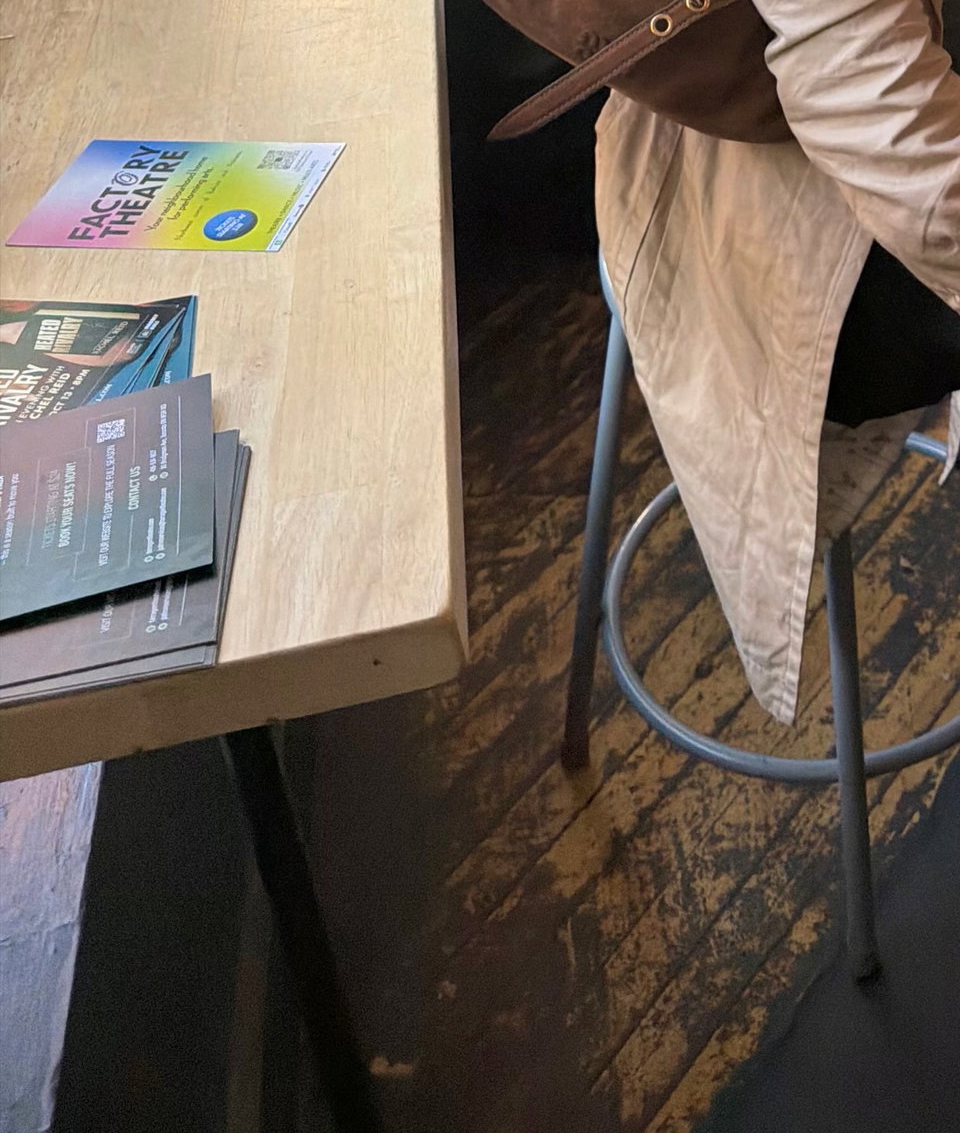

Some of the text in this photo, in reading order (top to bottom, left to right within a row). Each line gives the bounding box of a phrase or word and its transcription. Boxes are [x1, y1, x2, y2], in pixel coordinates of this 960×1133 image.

[98, 150, 189, 239] THEATRE
[161, 171, 197, 217] neighbourhood
[34, 318, 62, 351] HEATED
[51, 316, 83, 354] RIVALRY
[19, 365, 65, 419] EVENING WITH
[29, 372, 71, 420] CHEL REID
[61, 390, 73, 400] 13
[72, 368, 91, 386] 8PM
[106, 444, 116, 466] SEASON
[105, 466, 115, 480] FULL
[105, 479, 115, 491] THE
[128, 465, 141, 511] CONTACT US
[58, 461, 77, 548] BOOK YOUR SEATS NOW!
[104, 490, 114, 514] EXPLORE
[100, 541, 110, 553] OUR
[101, 520, 112, 542] WEBSITE
[98, 553, 109, 567] VISIT
